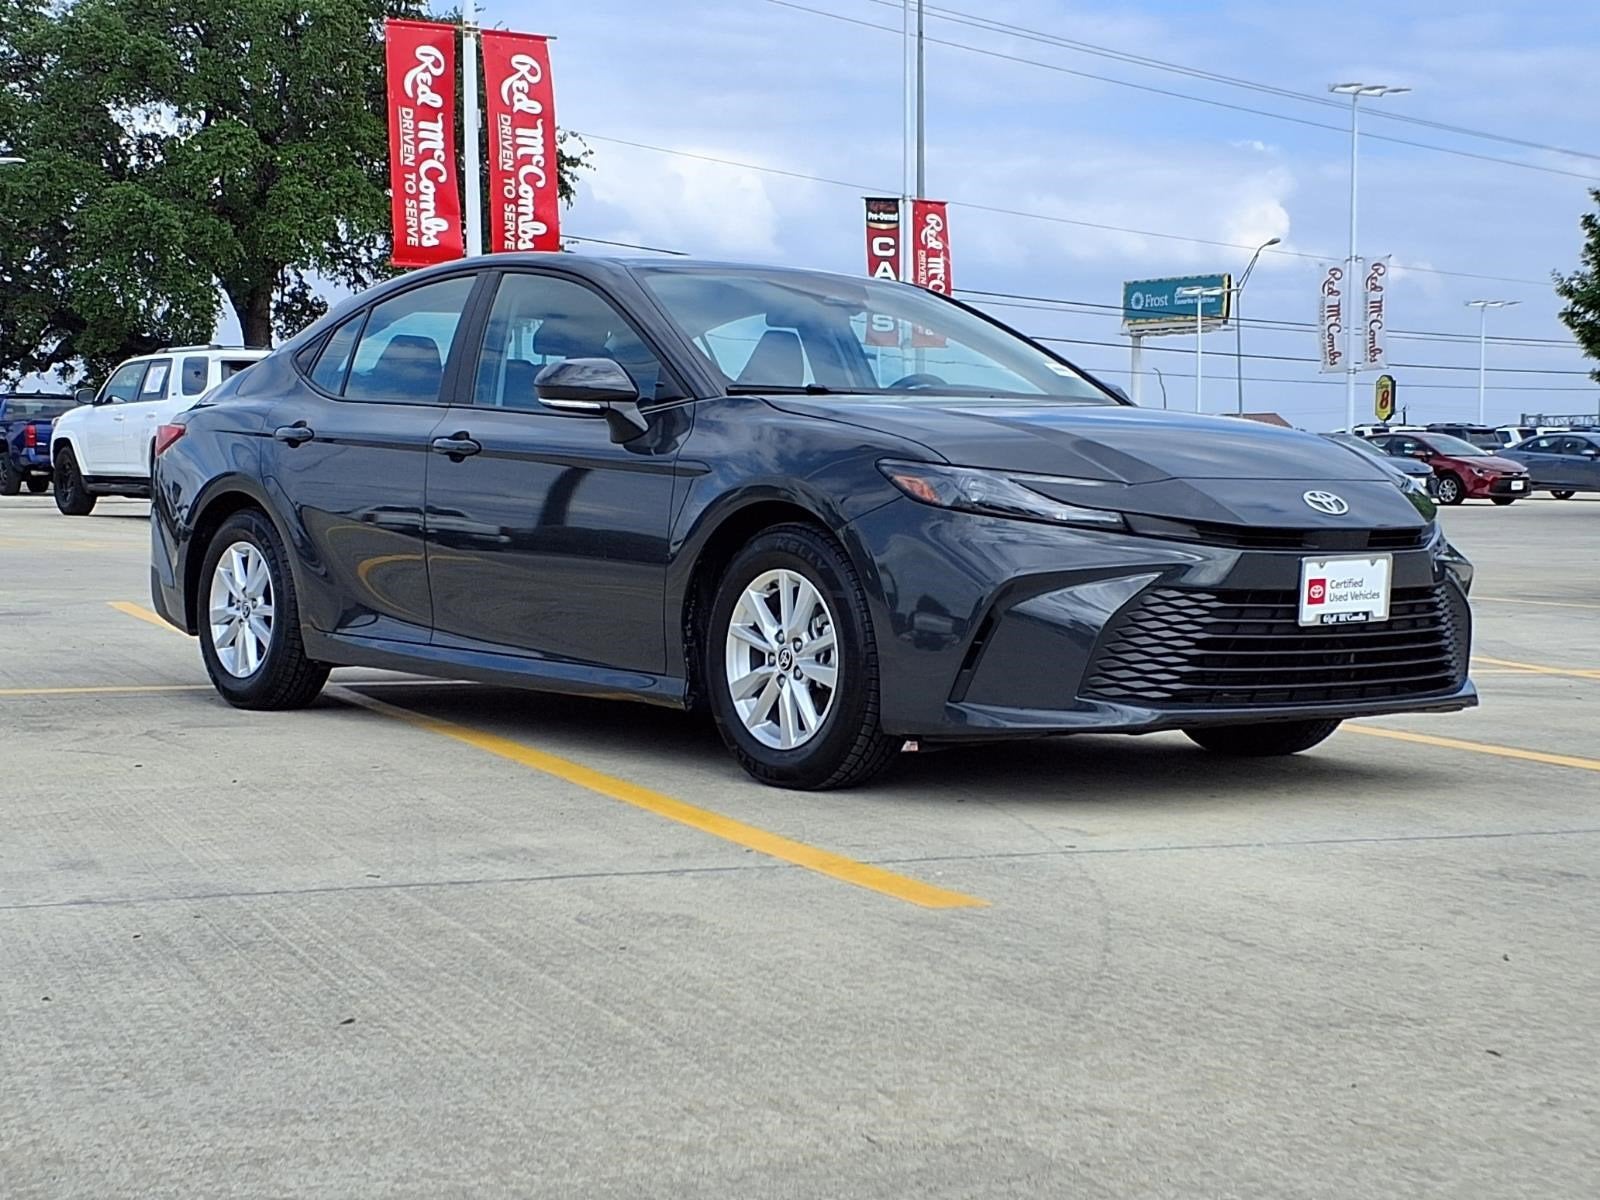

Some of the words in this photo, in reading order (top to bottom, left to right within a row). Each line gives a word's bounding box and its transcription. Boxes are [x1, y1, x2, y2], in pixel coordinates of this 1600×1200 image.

[404, 45, 445, 109] Red
[501, 54, 542, 115] Red
[402, 107, 416, 166] DRIVEN
[500, 114, 514, 171] DRIVEN
[404, 172, 417, 195] TO
[418, 112, 447, 248] McCombs
[503, 178, 516, 199] TO
[516, 119, 547, 251] McCombs
[405, 199, 419, 247] SERVE
[503, 204, 516, 250] SERVE
[921, 213, 943, 252] Red
[1322, 267, 1343, 297] Red
[1366, 262, 1386, 293] Red
[1144, 294, 1168, 308] Frost
[1326, 299, 1342, 366] McCombs
[1368, 294, 1384, 363] McCombs
[1379, 389, 1389, 410] 8
[1328, 592, 1349, 603] Used
[1350, 590, 1380, 601] Vehicles
[1329, 578, 1364, 590] Certified
